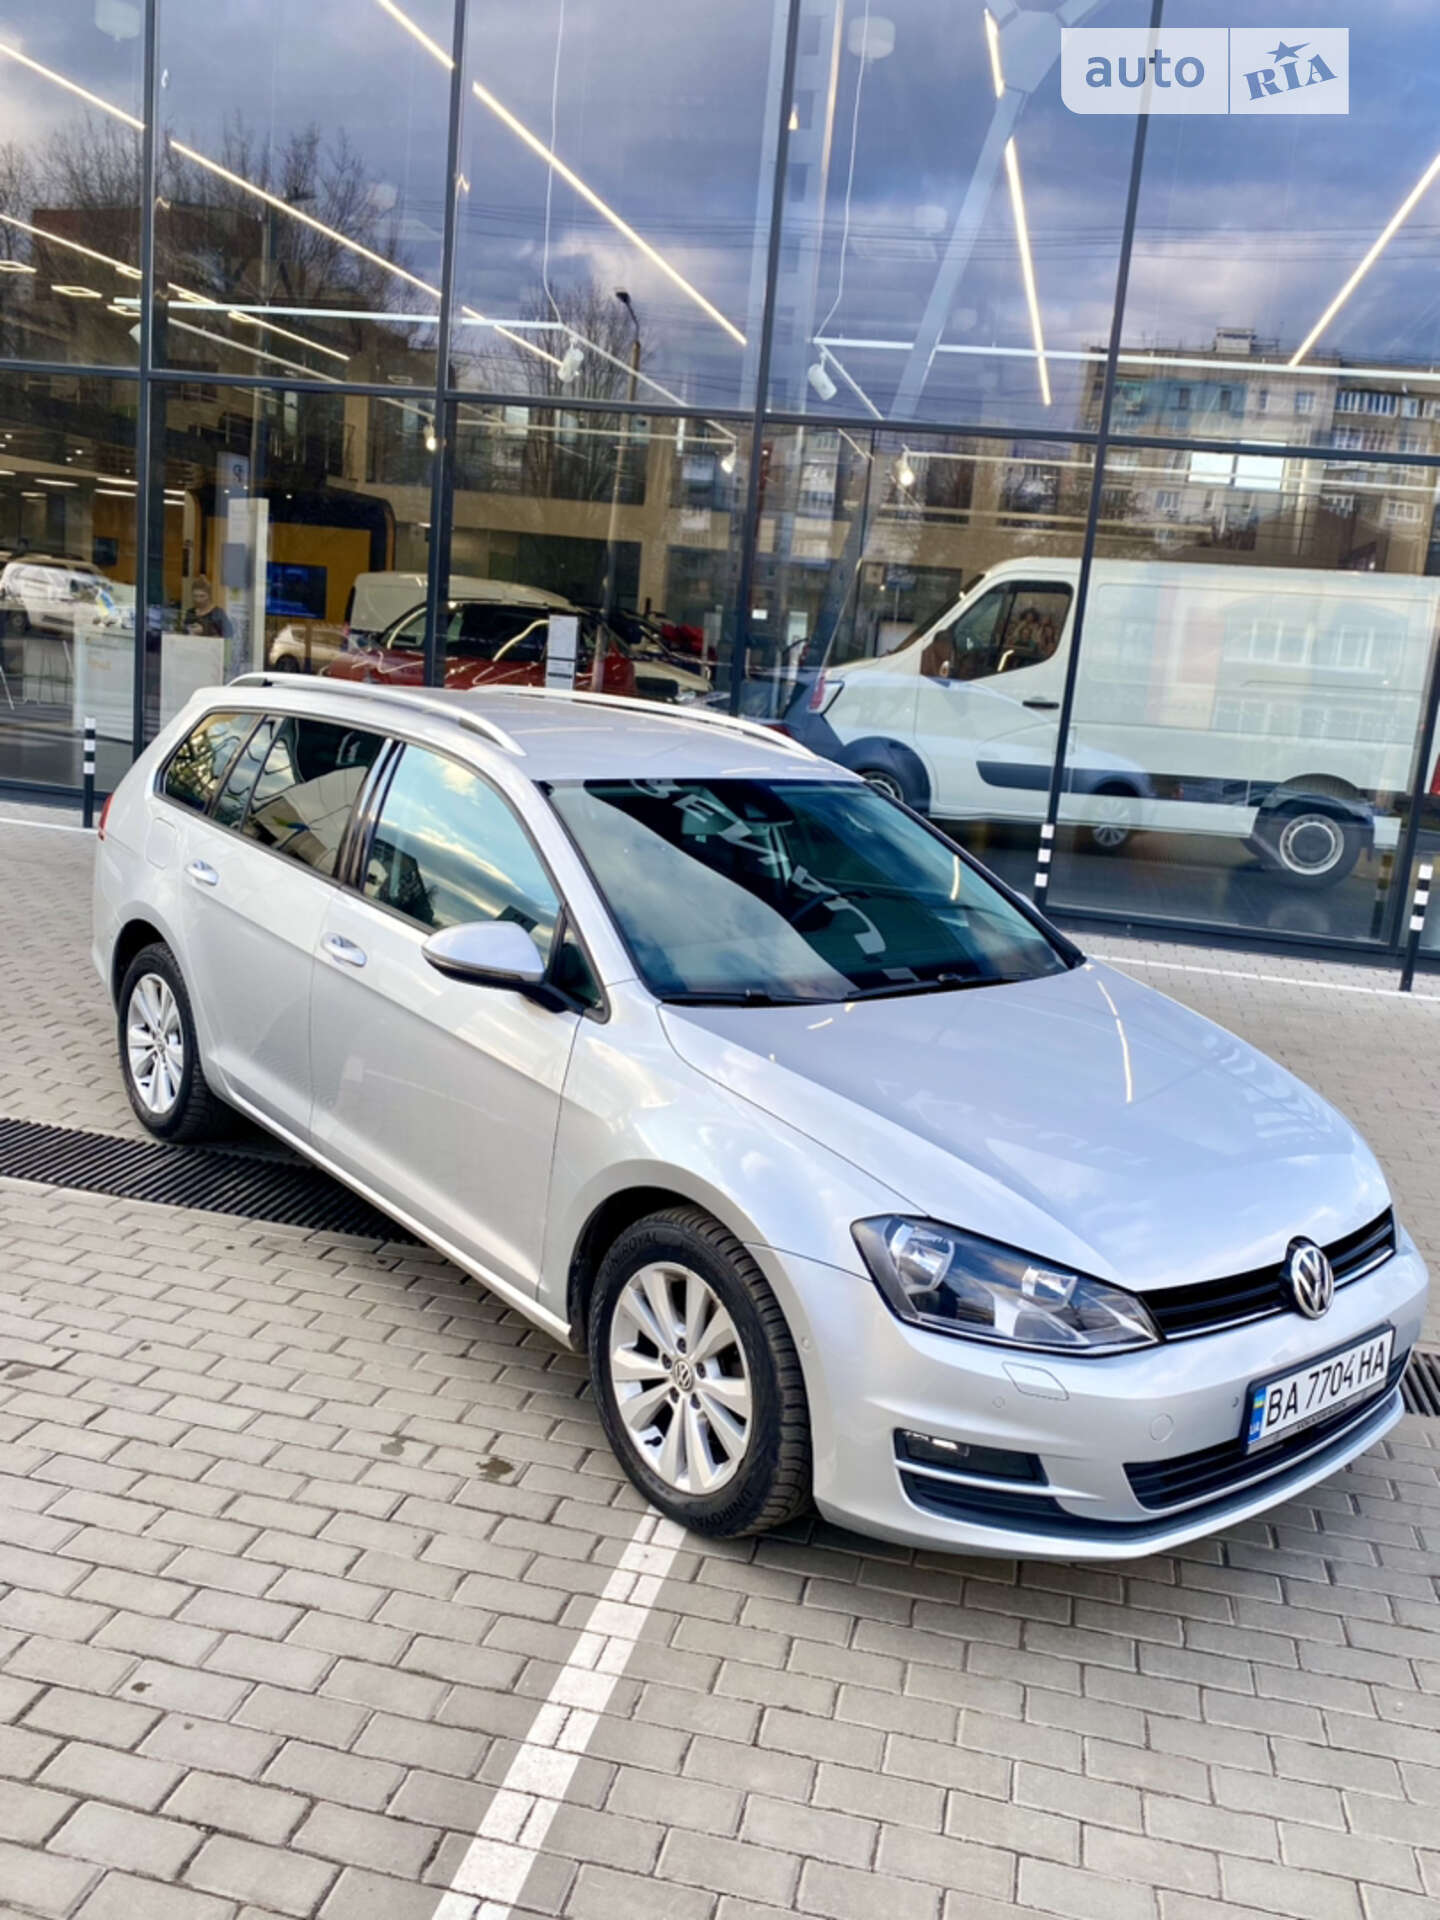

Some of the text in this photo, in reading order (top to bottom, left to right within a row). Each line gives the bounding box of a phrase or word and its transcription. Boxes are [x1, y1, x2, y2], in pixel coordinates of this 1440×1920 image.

[1266, 1381, 1298, 1427] BA
[1305, 1353, 1356, 1409] 7704
[1357, 1340, 1386, 1385] HA
